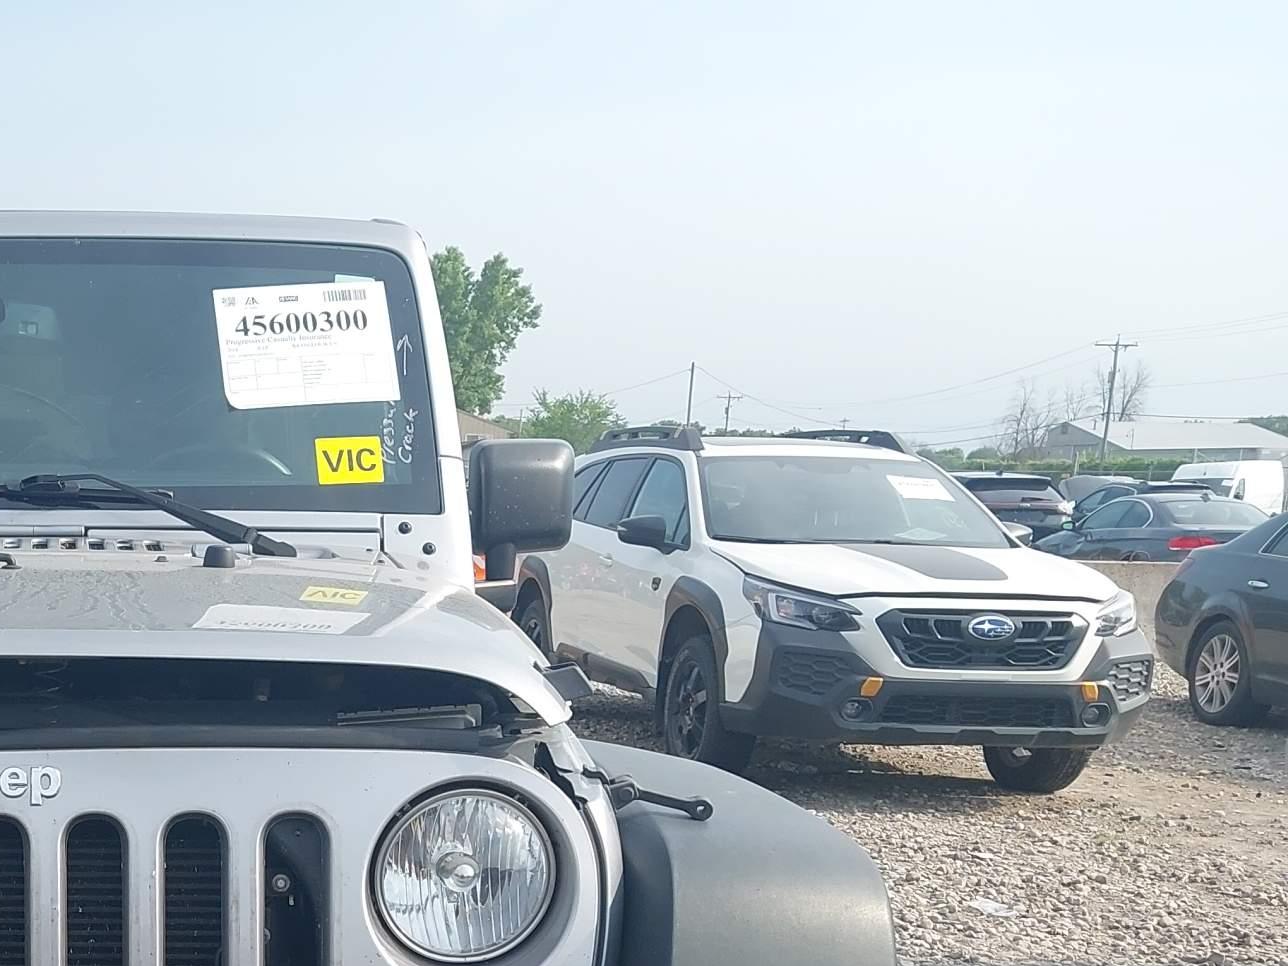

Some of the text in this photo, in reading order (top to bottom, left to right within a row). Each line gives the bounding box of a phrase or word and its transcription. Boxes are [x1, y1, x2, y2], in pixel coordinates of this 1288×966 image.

[235, 309, 368, 337] 45600300
[398, 408, 418, 463] Crack
[322, 448, 377, 473] VIC
